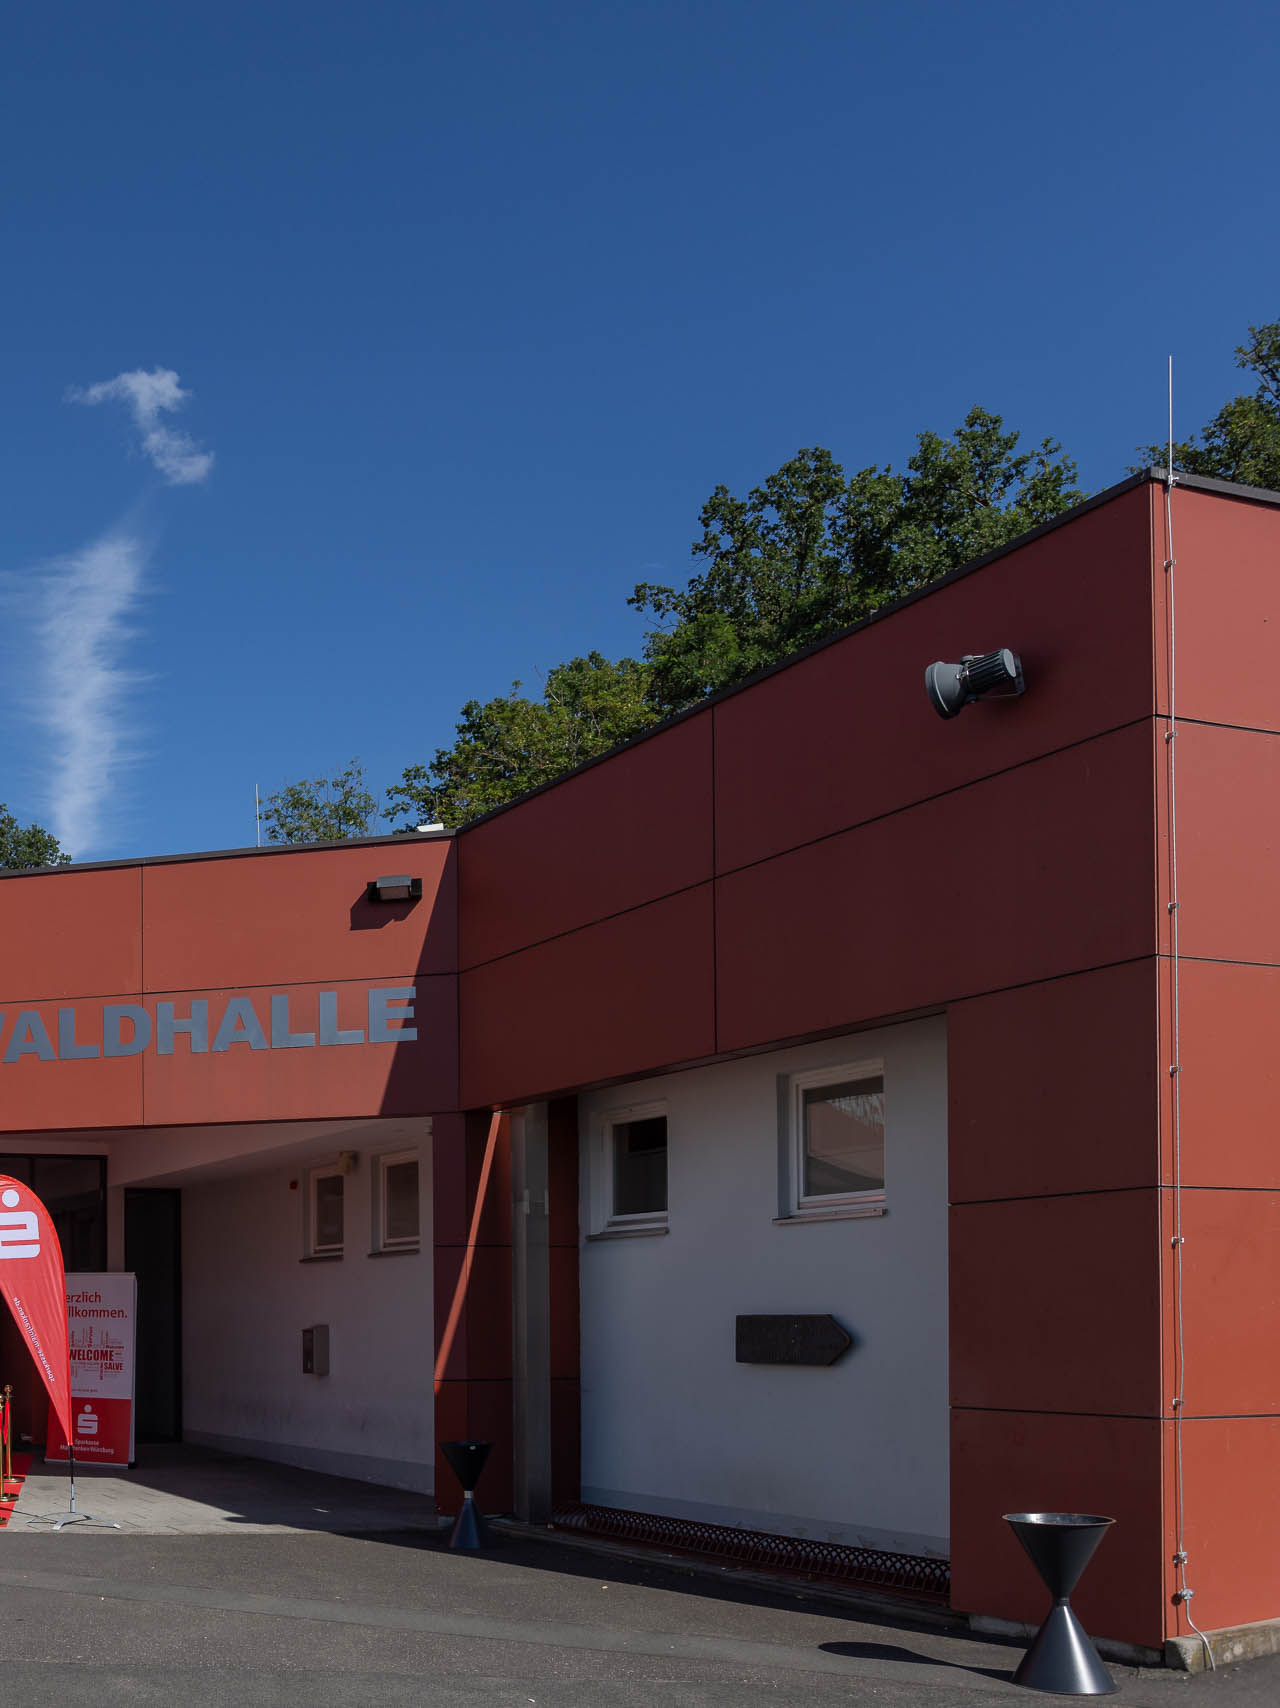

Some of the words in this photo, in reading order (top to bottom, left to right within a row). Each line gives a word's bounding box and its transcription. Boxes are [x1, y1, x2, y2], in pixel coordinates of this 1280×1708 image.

[66, 1291, 101, 1303] erzlich
[68, 1306, 128, 1318] llkommen.
[69, 1349, 115, 1361] WELCOME
[104, 1362, 124, 1370] SALVE
